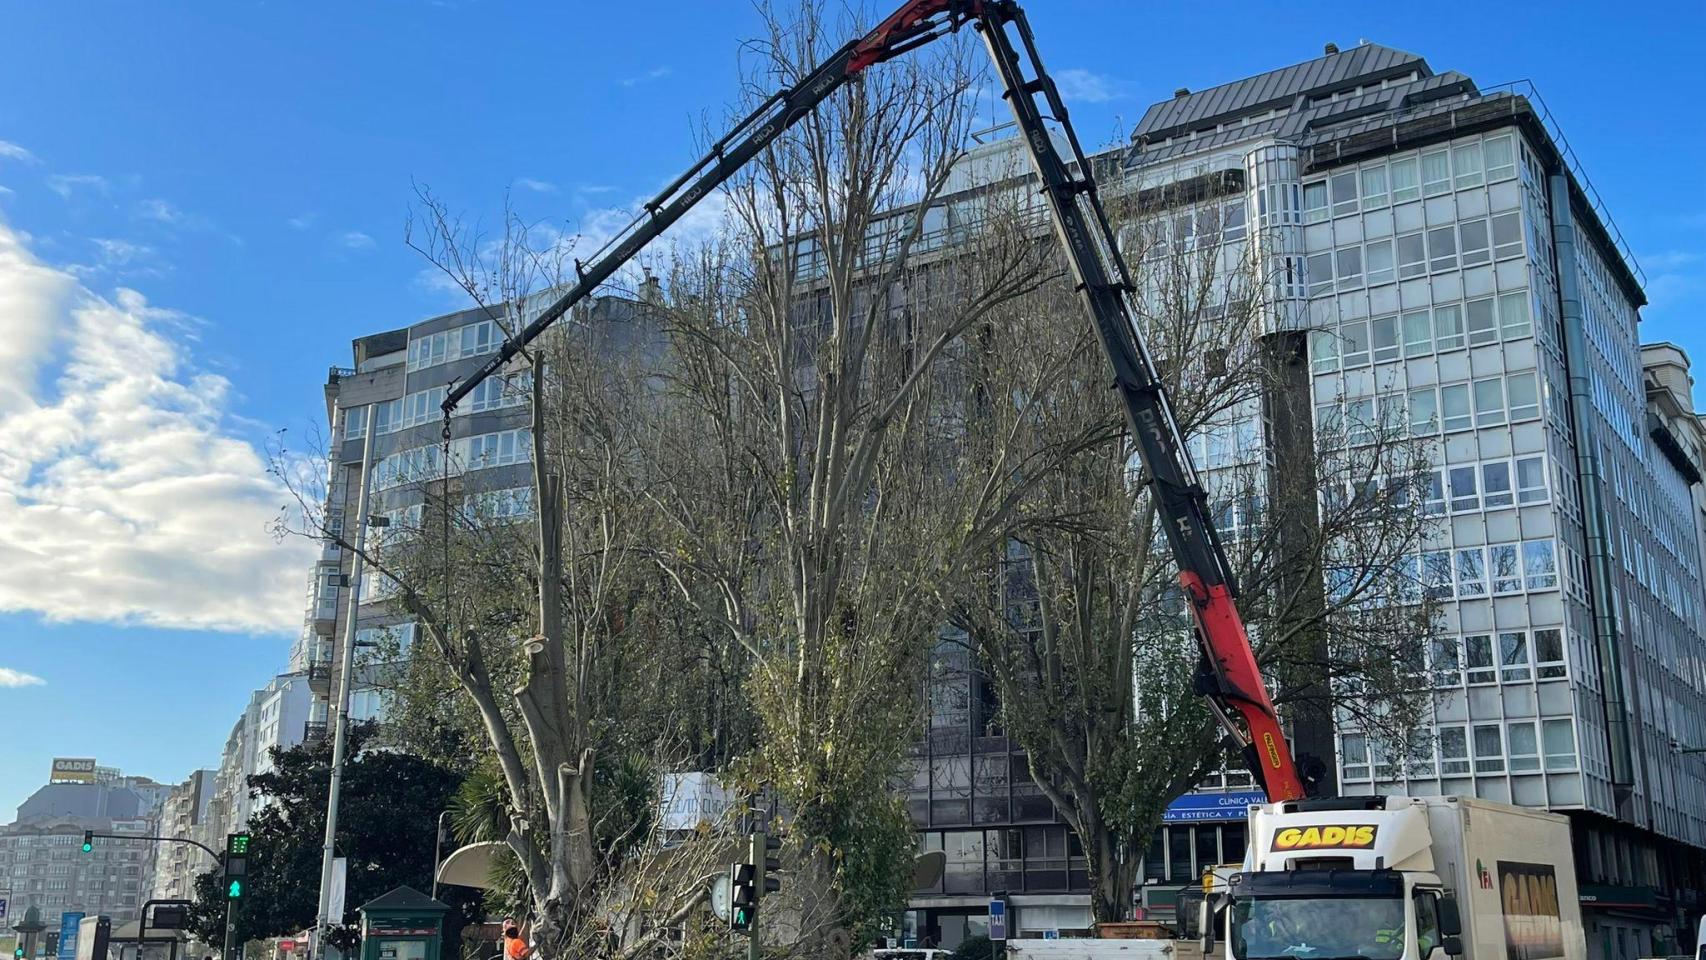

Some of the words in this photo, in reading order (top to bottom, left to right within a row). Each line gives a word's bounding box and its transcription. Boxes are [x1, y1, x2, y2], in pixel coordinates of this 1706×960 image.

[813, 75, 835, 95] RICO
[752, 125, 775, 145] RICO
[1264, 733, 1280, 766] PALFINGER
[56, 761, 94, 771] GADIS
[1181, 811, 1222, 819] ESTÉTICA
[1276, 826, 1375, 848] GADIS
[991, 914, 1005, 927] TAXI
